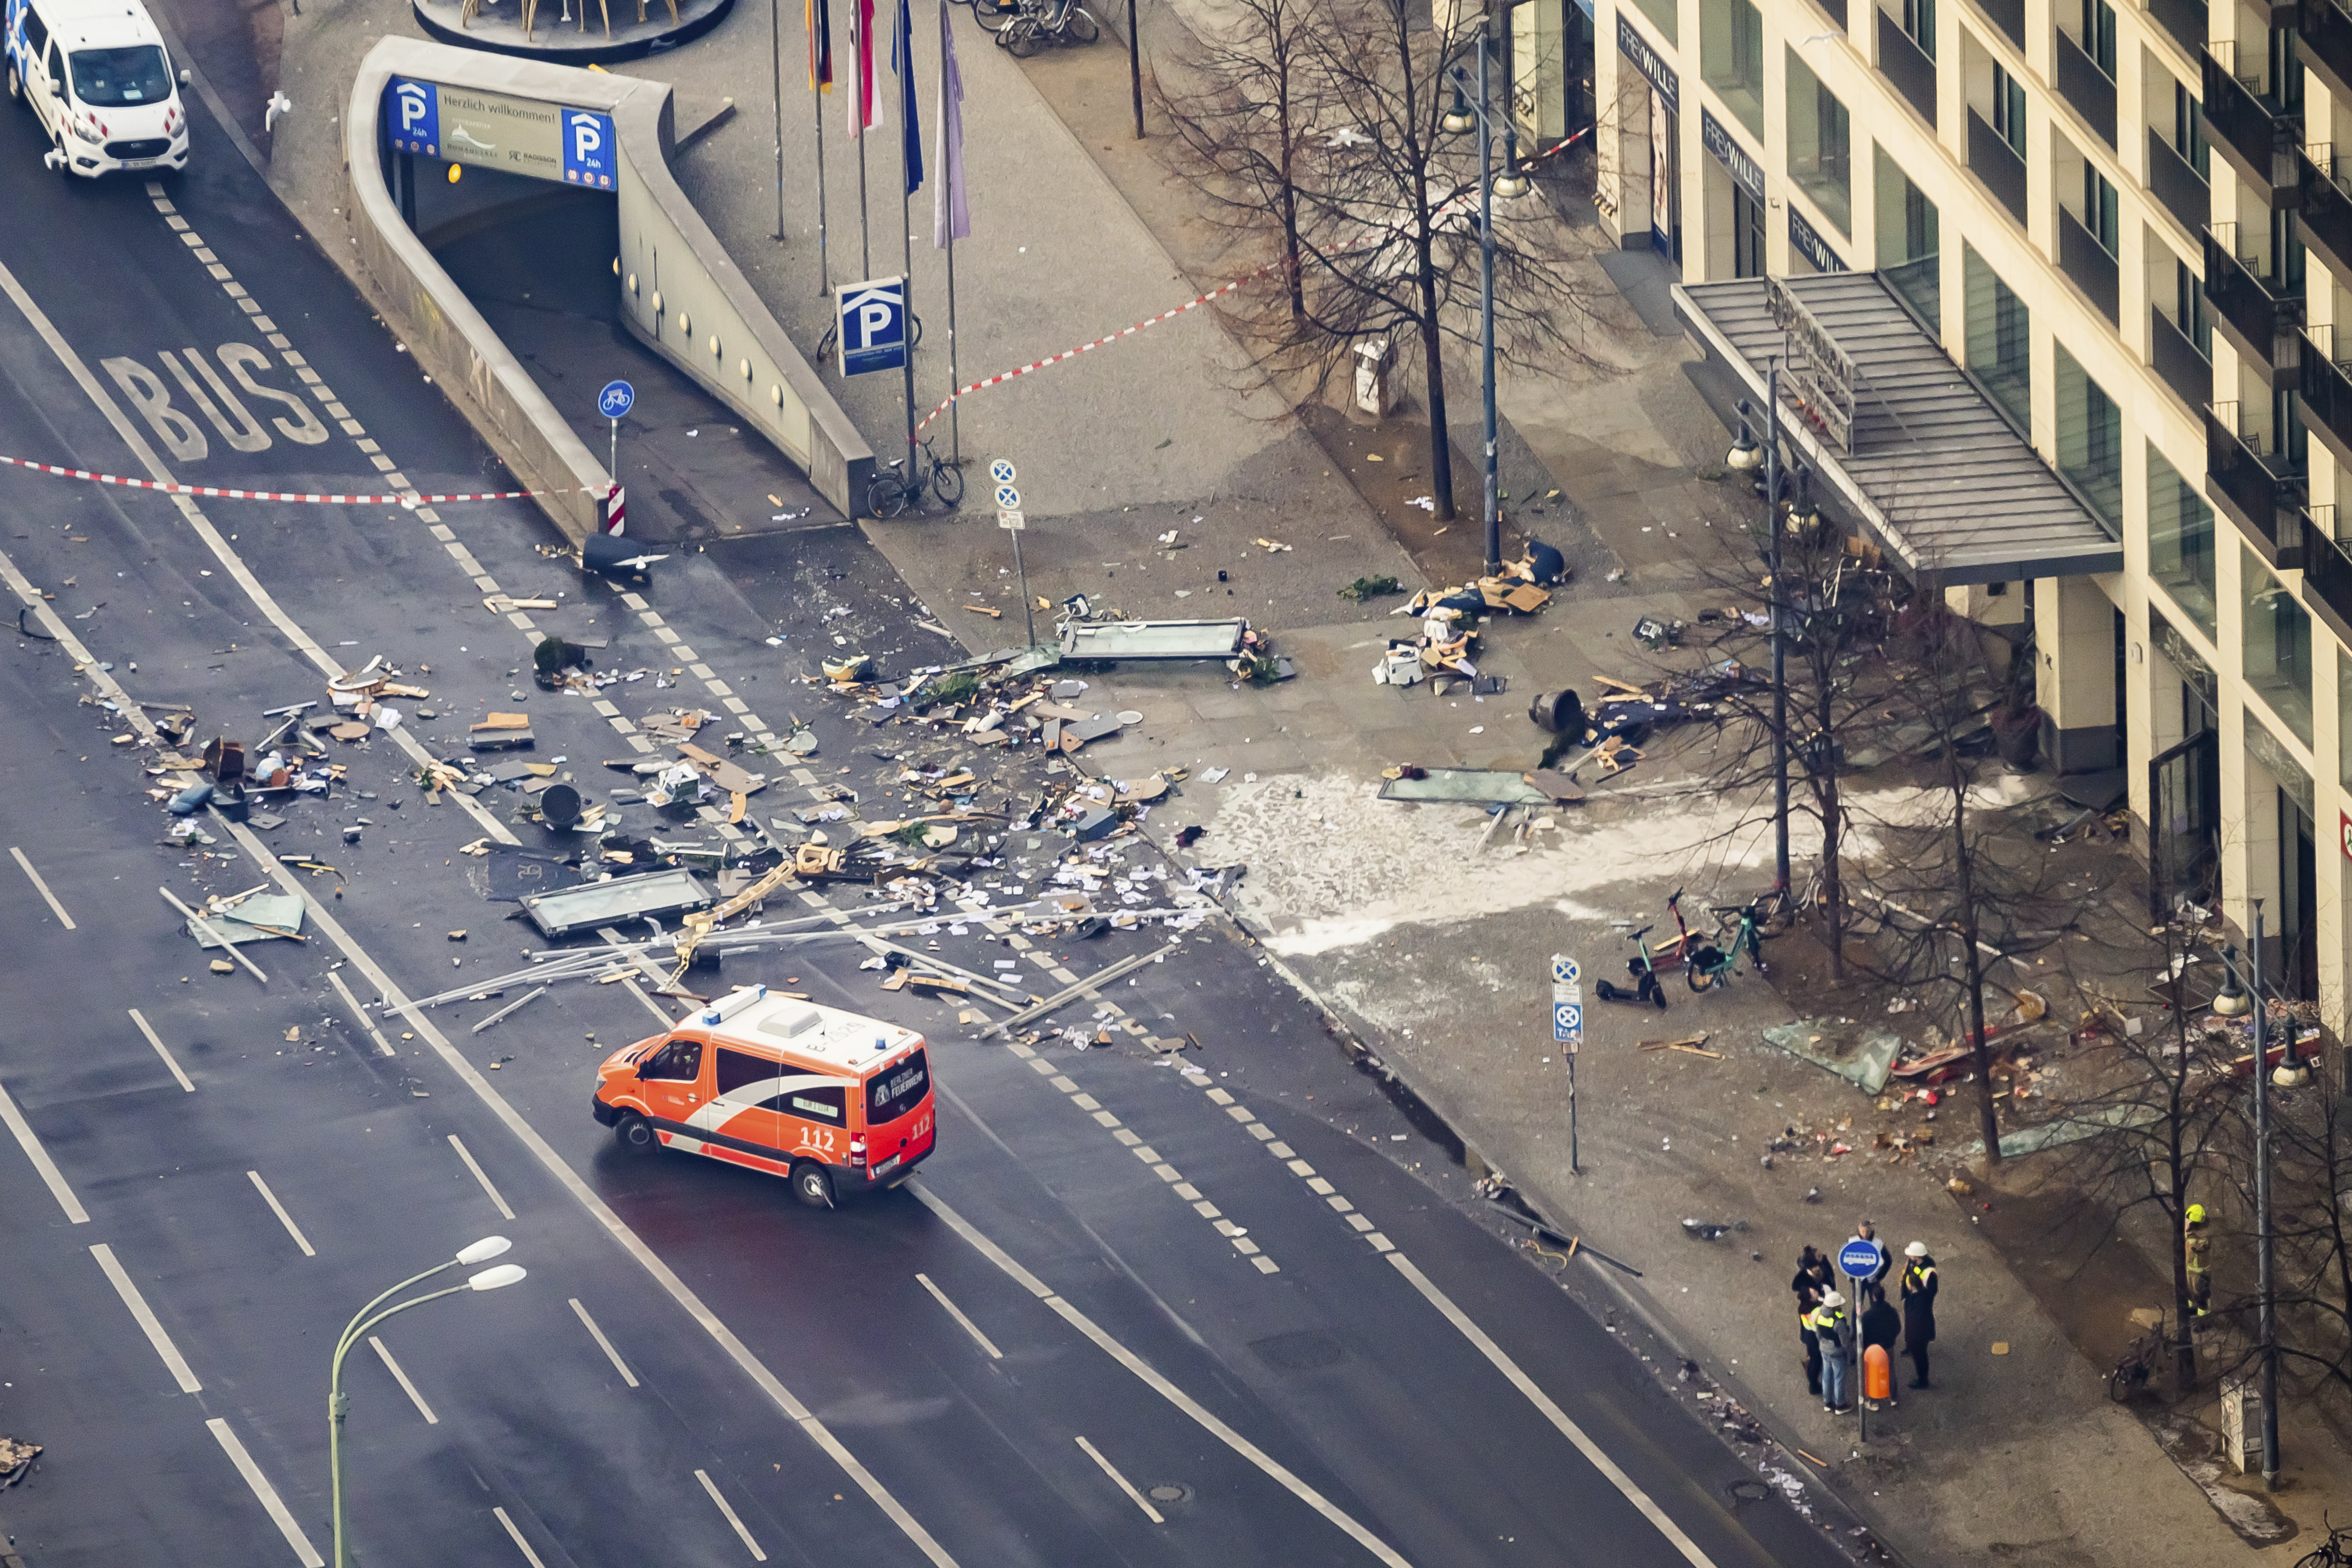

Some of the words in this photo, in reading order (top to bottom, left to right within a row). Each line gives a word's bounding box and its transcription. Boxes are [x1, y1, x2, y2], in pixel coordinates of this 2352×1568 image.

[1620, 22, 1676, 101] FREYWILLE
[402, 95, 426, 130] P
[444, 94, 485, 111] Herzlich
[488, 103, 555, 123] willkommen!
[412, 127, 427, 137] 24h
[576, 126, 600, 161] P
[586, 157, 601, 168] 24h
[1706, 117, 1761, 197] FREYWILLE
[1793, 215, 1839, 273] FREYWIL
[860, 303, 891, 348] P
[100, 342, 329, 461] BUS
[800, 1127, 834, 1152] 112
[912, 1114, 930, 1140] 112
